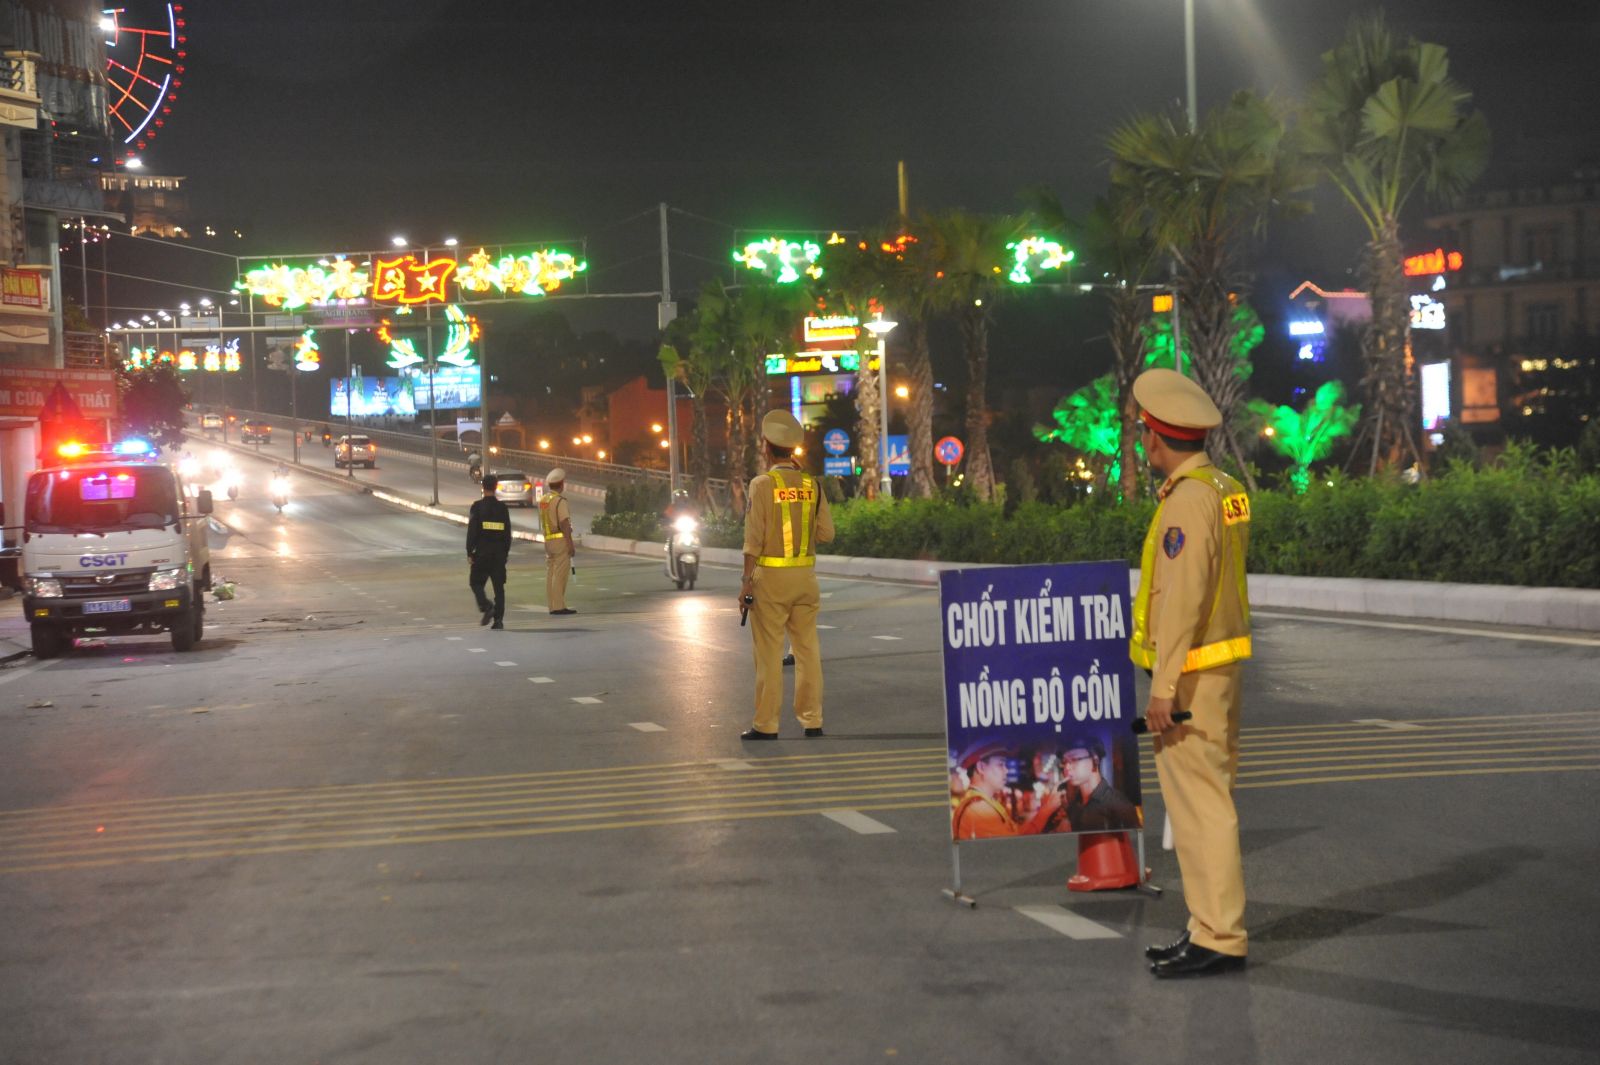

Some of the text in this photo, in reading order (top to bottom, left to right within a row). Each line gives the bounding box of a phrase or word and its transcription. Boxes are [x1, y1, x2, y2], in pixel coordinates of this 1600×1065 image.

[78, 388, 111, 408] THẤT
[778, 490, 813, 500] C.S.G.T
[79, 553, 128, 568] CSGT
[946, 578, 1126, 648] CHỐT KIỂM TRA
[958, 659, 1121, 732] NỒNG ĐỘ CỒN
